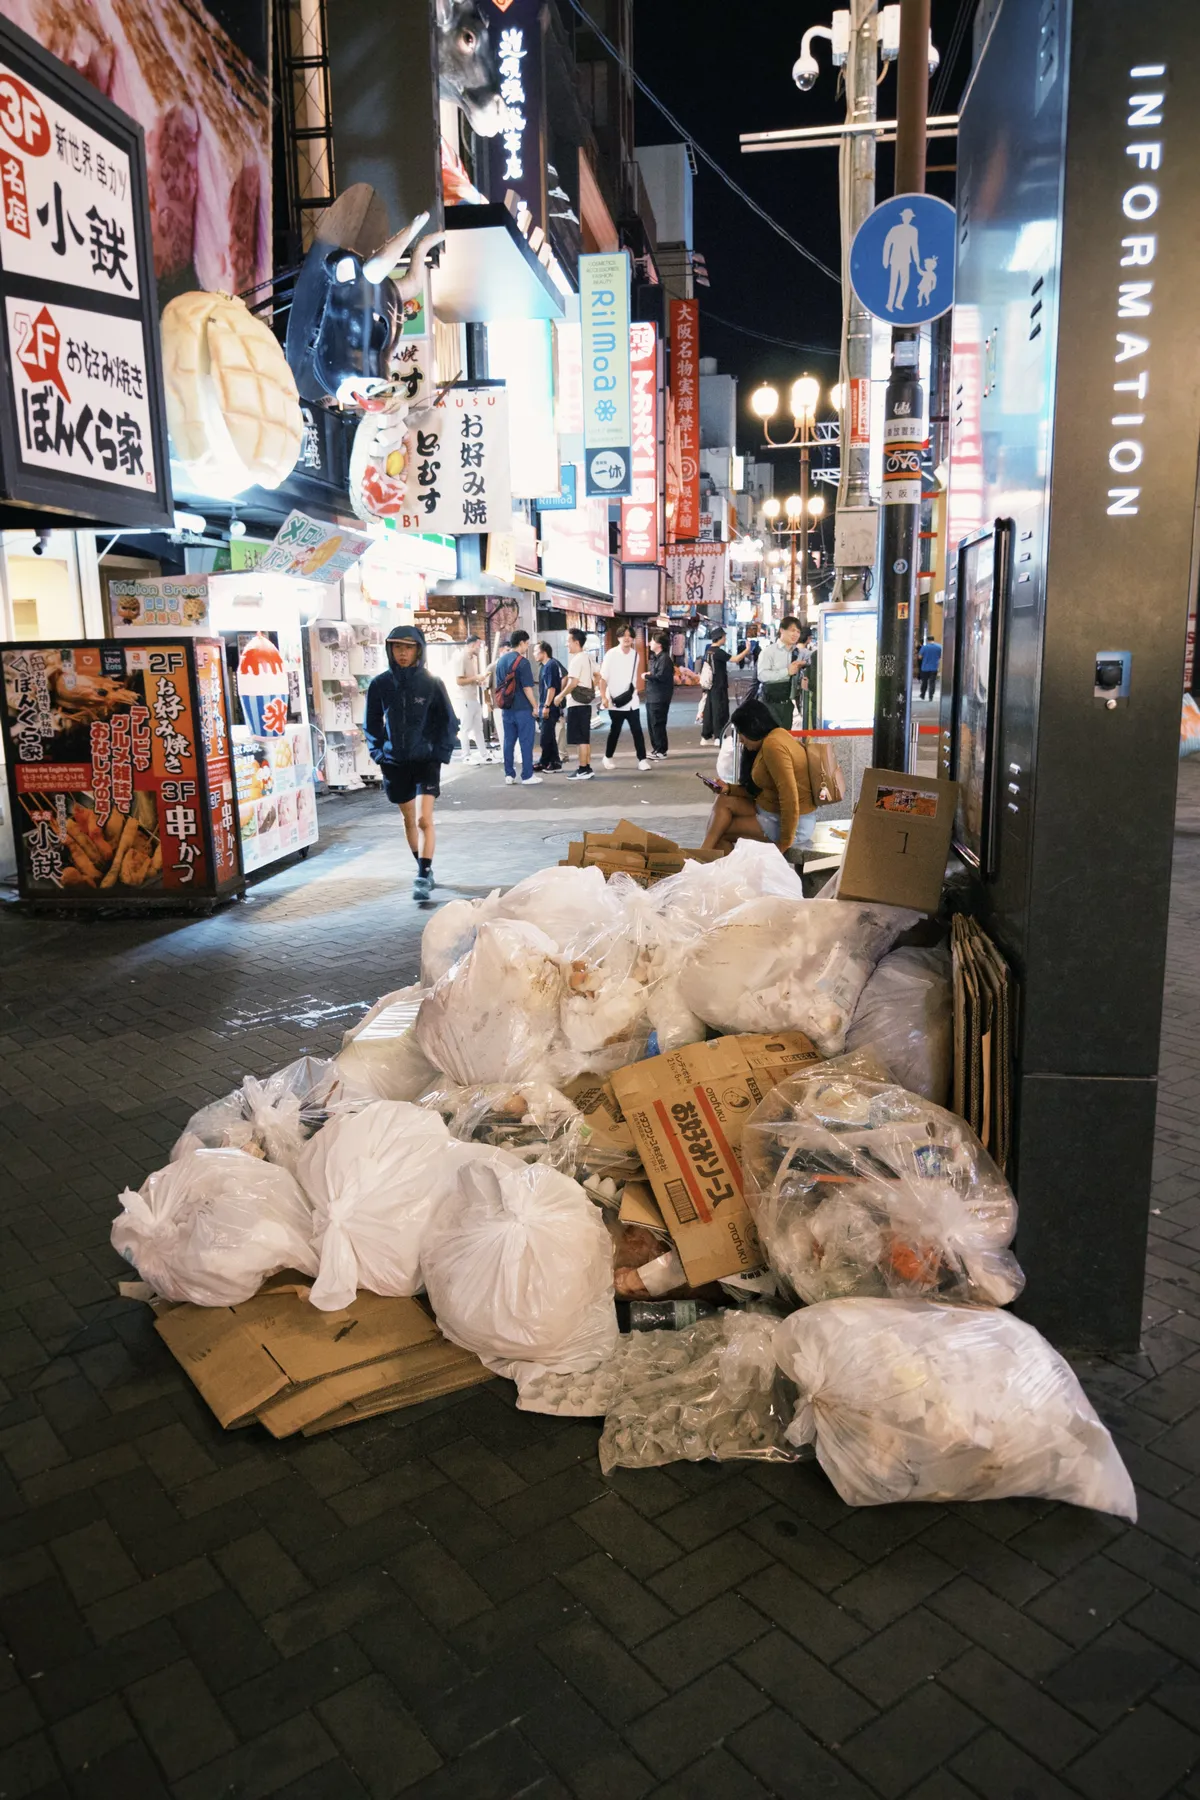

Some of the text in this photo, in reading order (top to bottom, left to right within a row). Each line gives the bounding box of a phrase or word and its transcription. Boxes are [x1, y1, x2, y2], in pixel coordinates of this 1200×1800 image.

[0, 78, 42, 147] 3F
[3, 159, 28, 234] 名店
[36, 181, 133, 292] 小鉄
[1106, 63, 1166, 517] INFORMATION
[14, 311, 57, 370] 2F
[66, 337, 143, 400] お好み焼き
[22, 385, 144, 476] ぼんくら家
[460, 412, 487, 525] お好み焼
[594, 464, 622, 479] 一休
[402, 514, 420, 529] B1
[113, 582, 207, 596] Melon Bread
[686, 557, 705, 600] 射的
[104, 656, 121, 664] Uber
[105, 663, 122, 671] Eats
[150, 652, 184, 675] 2F
[14, 678, 43, 761] ぼんくら家
[130, 705, 150, 772] テレビや
[153, 677, 192, 774] お好み焼き
[262, 697, 288, 735] 氷
[111, 714, 133, 814] グルメ雑誌で
[161, 780, 196, 803] 3F
[165, 804, 201, 883] 串かつ
[221, 801, 236, 868] 串かつ
[637, 1111, 669, 1172] オタフクソース株式会社
[671, 1101, 735, 1209] お好みソース
